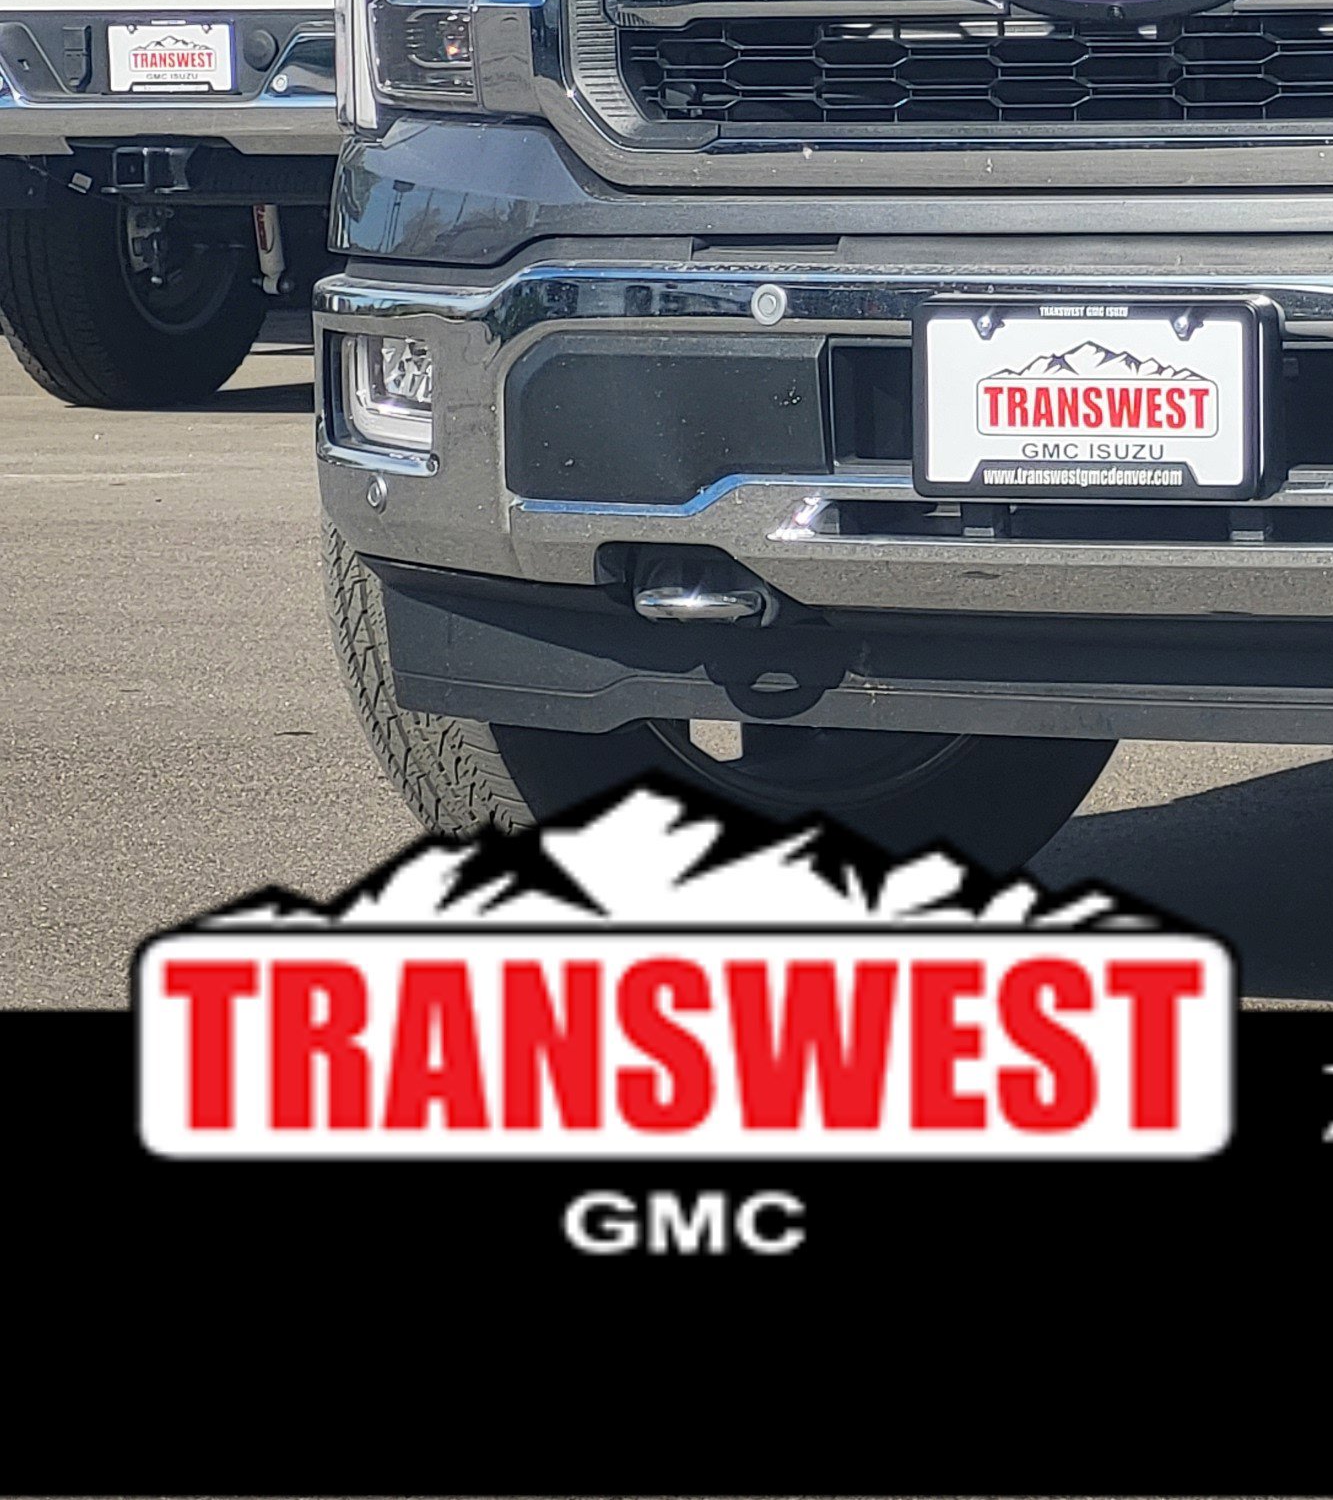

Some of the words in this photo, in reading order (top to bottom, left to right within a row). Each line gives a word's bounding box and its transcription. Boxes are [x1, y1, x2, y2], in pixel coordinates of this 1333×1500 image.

[132, 52, 213, 68] TRANSWEST
[1039, 306, 1084, 317] TRANSWEST
[984, 386, 1210, 429] TRANSWEST
[1022, 443, 1079, 459] GMC
[1089, 443, 1164, 461] ISUZU
[983, 466, 1183, 487] www.transwestgmcdenver.com
